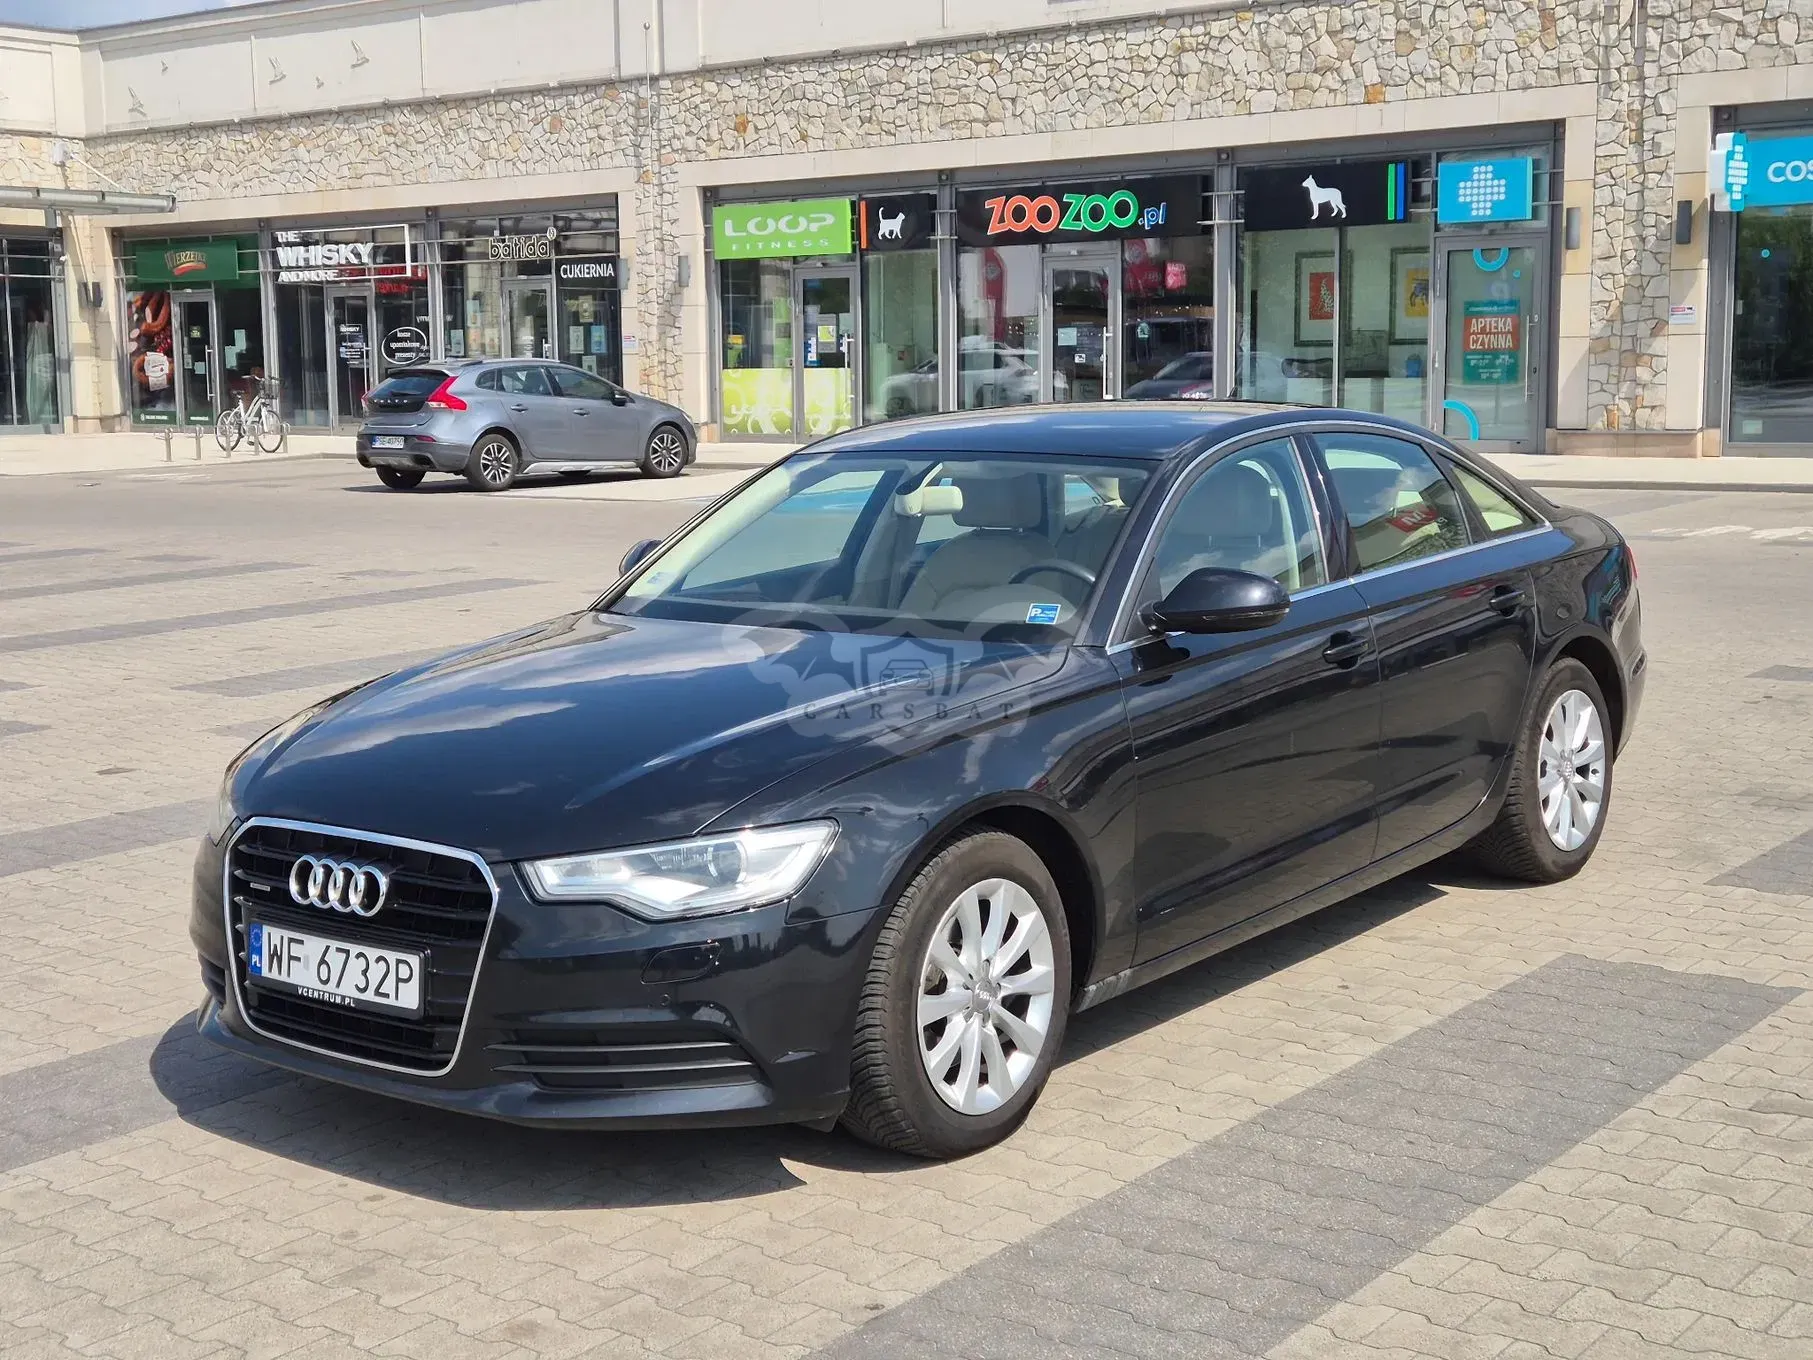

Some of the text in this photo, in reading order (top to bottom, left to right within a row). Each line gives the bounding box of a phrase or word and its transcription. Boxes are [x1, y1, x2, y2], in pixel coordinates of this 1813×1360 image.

[724, 213, 836, 237] LOOP
[275, 231, 300, 243] THE
[732, 238, 829, 250] FITNESS
[276, 242, 375, 267] WHISKY
[488, 235, 550, 260] batida
[278, 271, 304, 283] AND
[303, 269, 339, 282] MORE
[560, 262, 615, 279] CUKIERNIA
[1470, 317, 1513, 333] APTEKA
[1469, 333, 1513, 350] CZYNNA
[251, 954, 261, 968] PL
[267, 931, 414, 1001] WF 6732P
[297, 986, 356, 1008] VCENTRUM.PL
